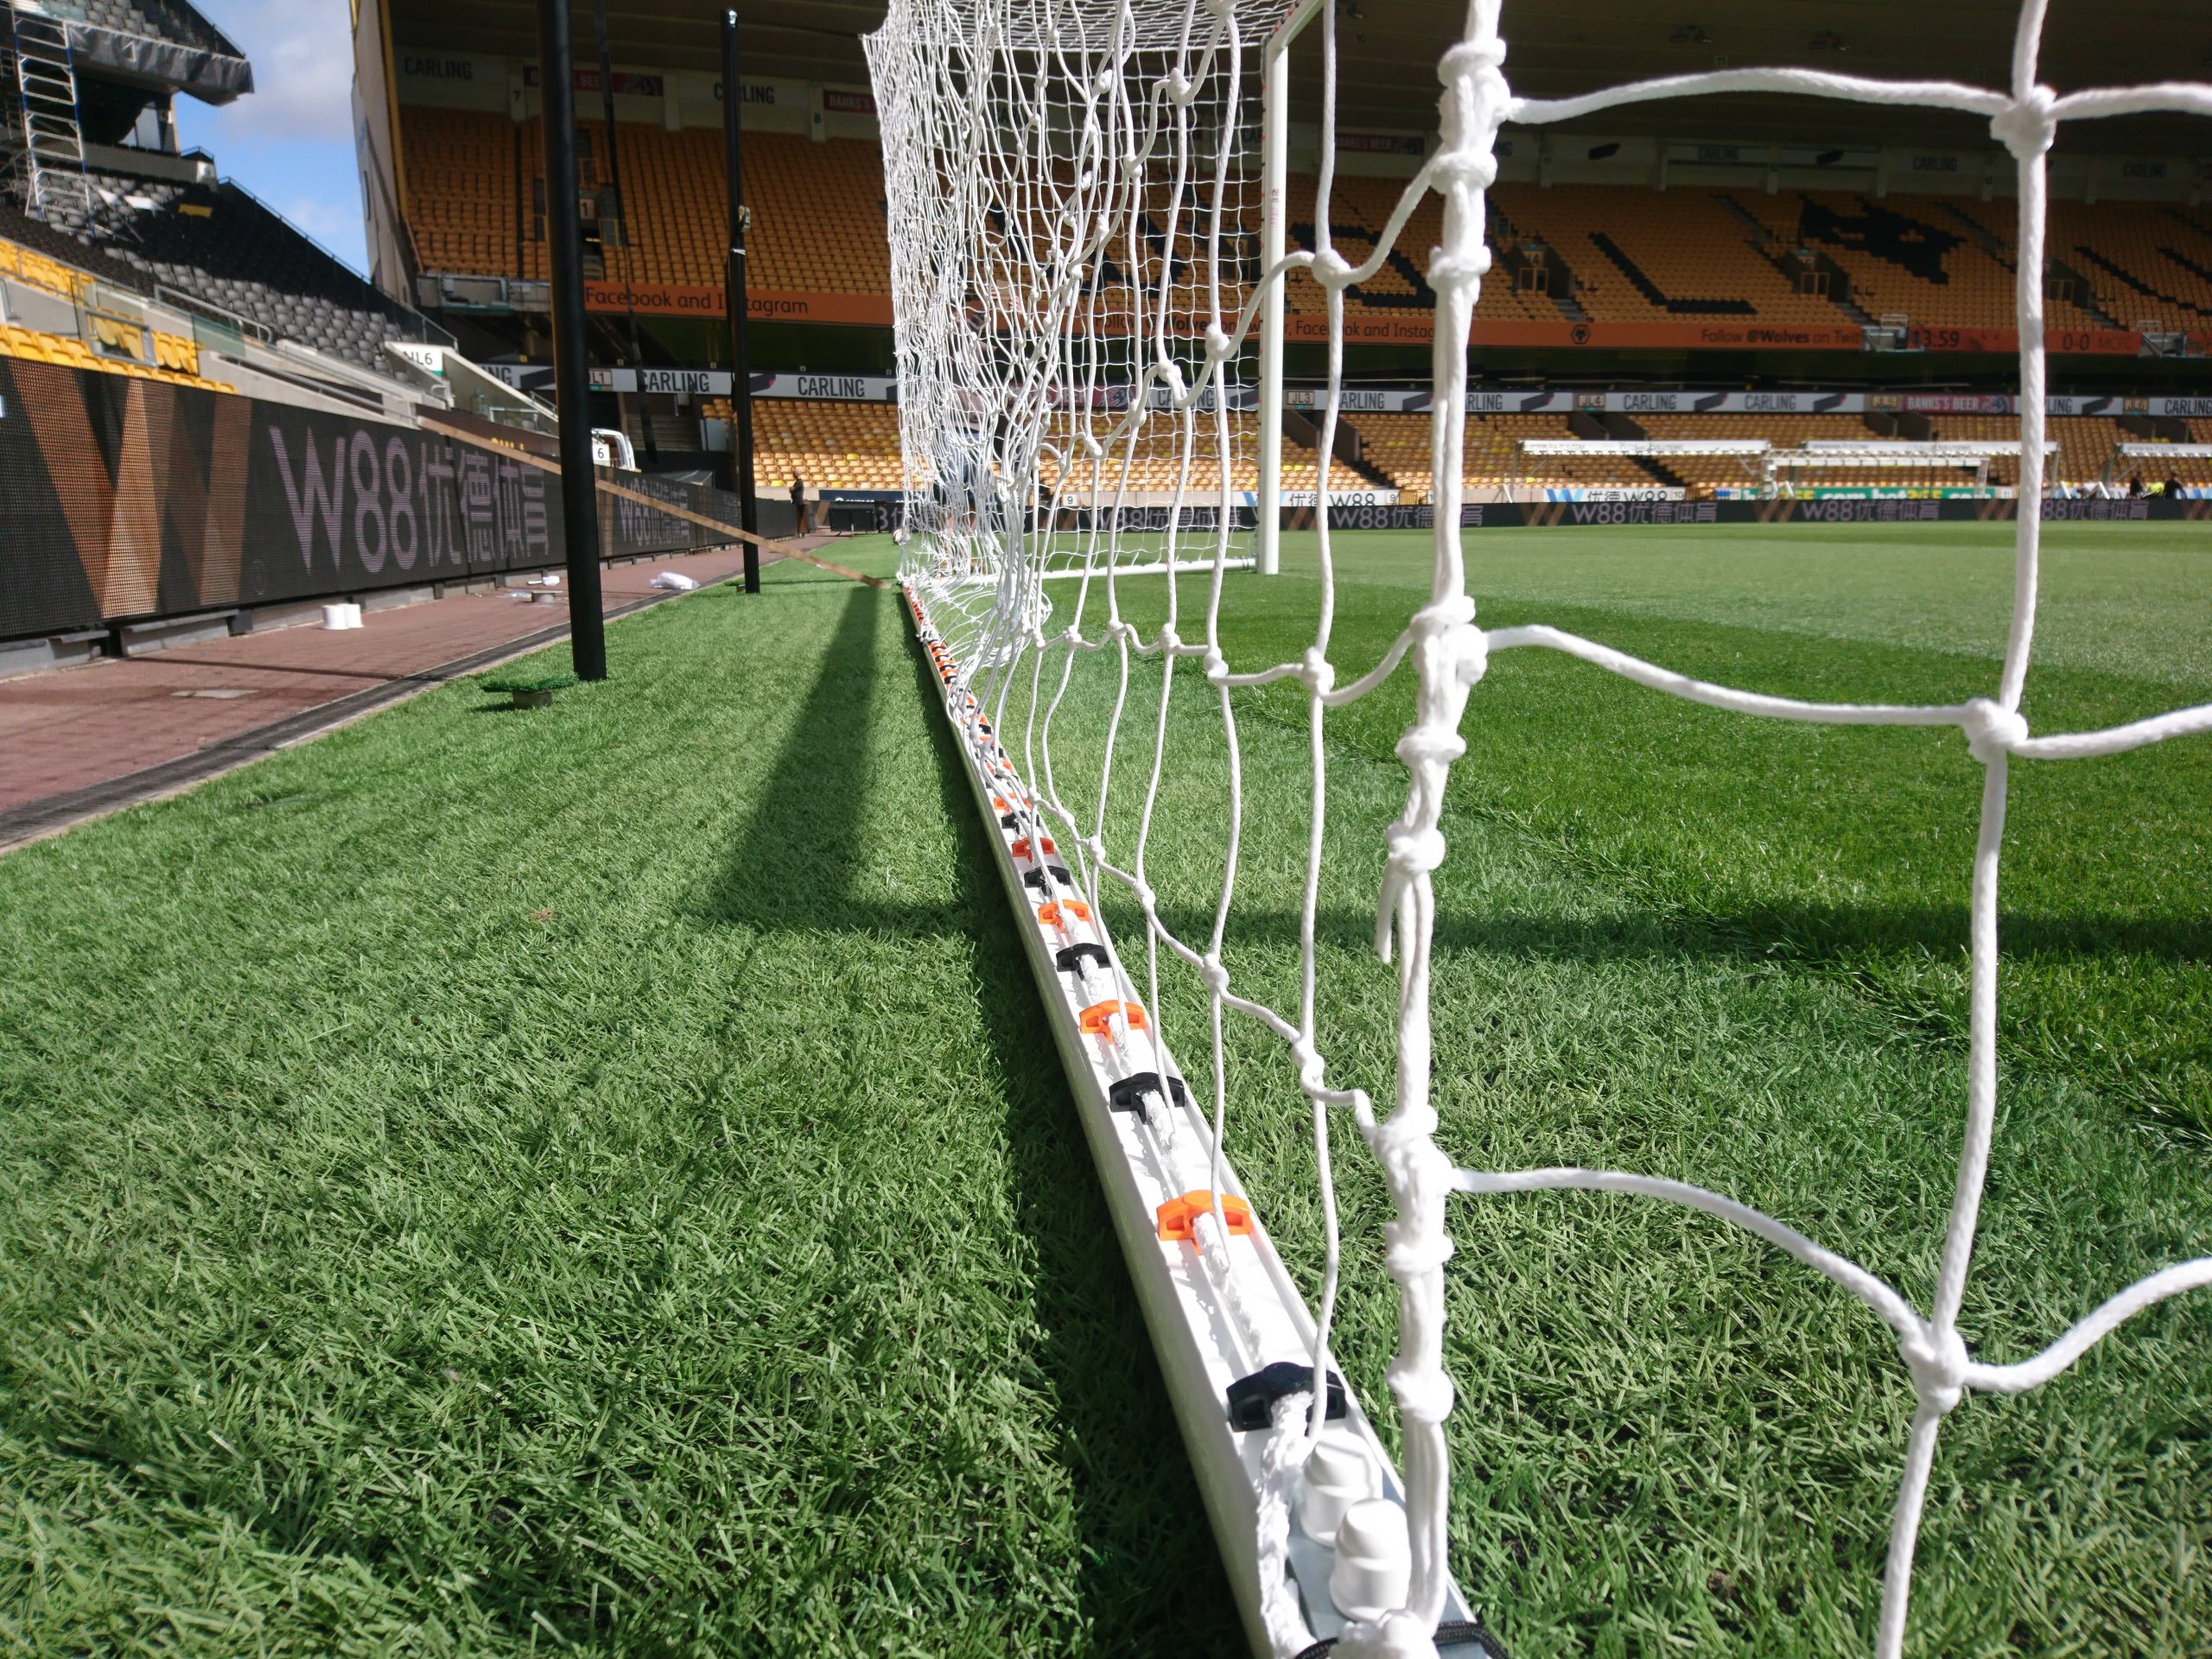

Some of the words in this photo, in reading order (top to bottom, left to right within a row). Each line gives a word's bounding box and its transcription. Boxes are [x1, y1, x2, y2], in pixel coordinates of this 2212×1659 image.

[404, 56, 473, 80] CARLING
[714, 82, 775, 105] CLING
[677, 293, 711, 310] and
[716, 293, 809, 317] Itagram
[1364, 321, 1389, 338] and
[1701, 328, 1744, 344] Follow
[1747, 329, 1810, 344] @Wolves
[798, 376, 865, 397] CARLING
[1339, 392, 1385, 410] ARLING
[1466, 394, 1503, 411] RLING
[1624, 394, 1677, 410] CARLING
[1744, 394, 1797, 410] CARLING
[1952, 397, 1980, 411] BEER
